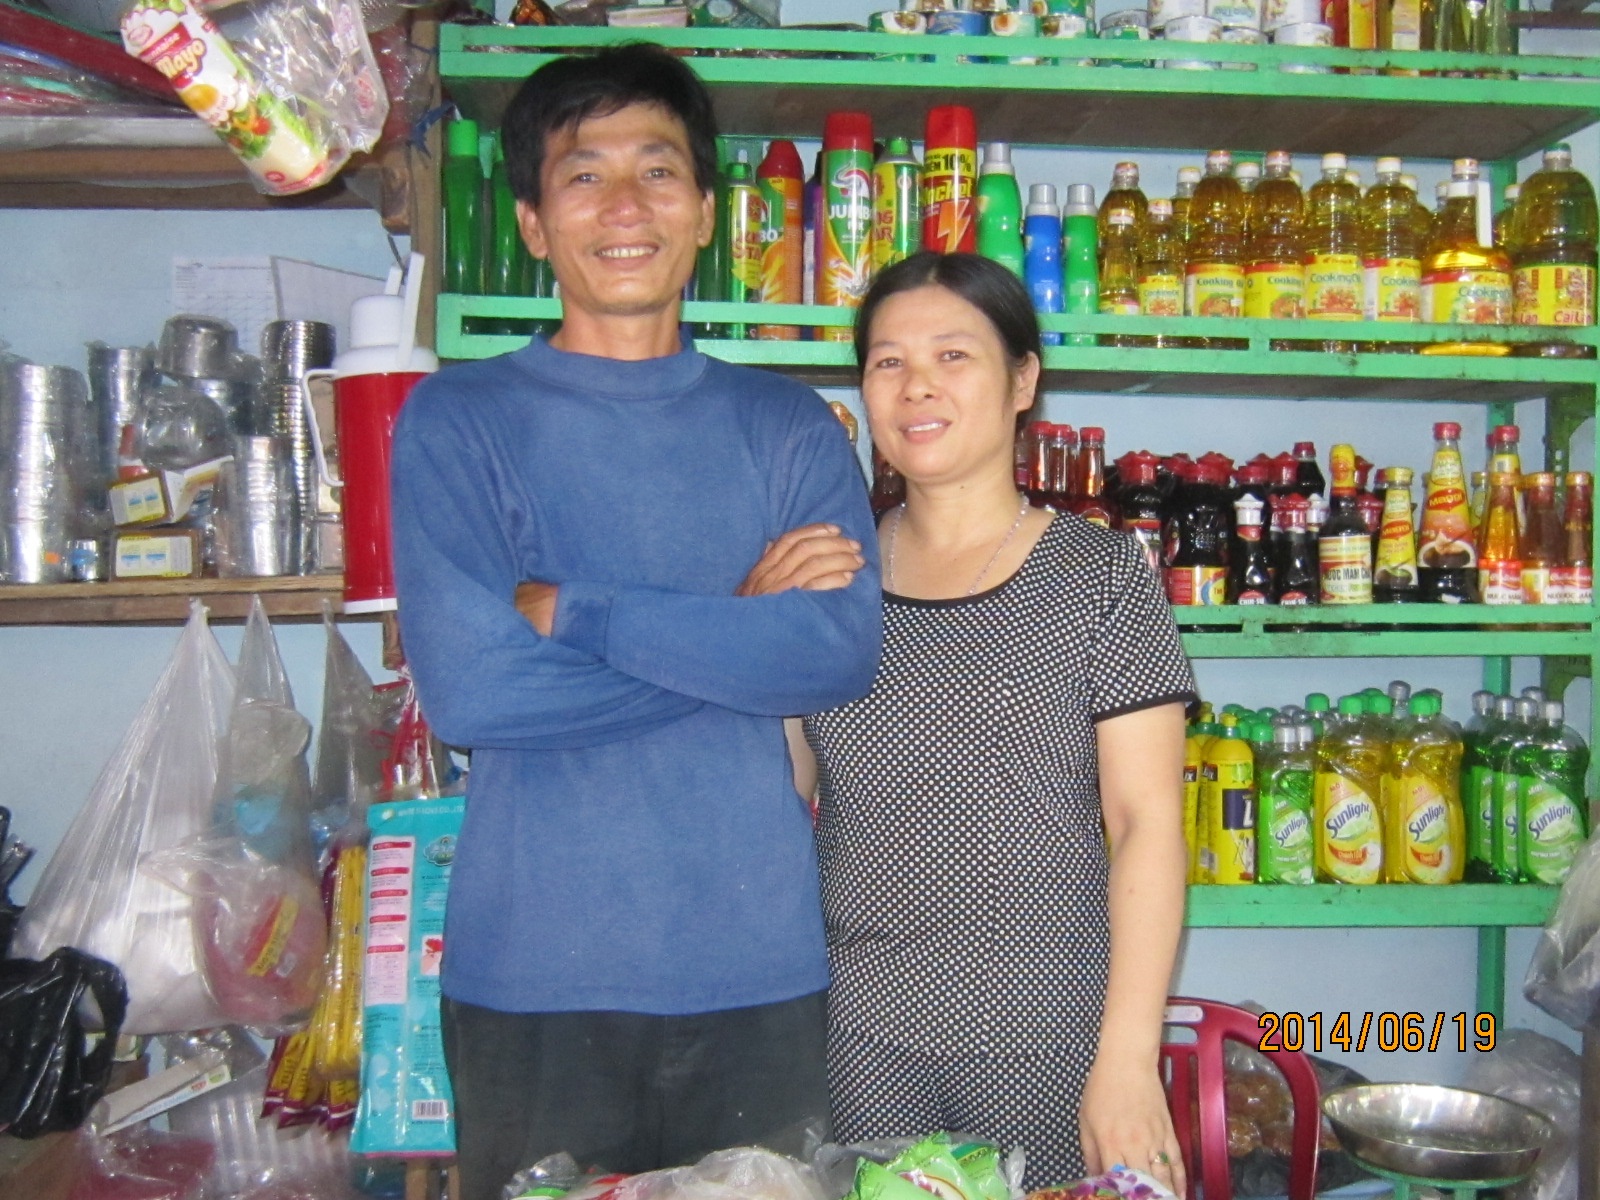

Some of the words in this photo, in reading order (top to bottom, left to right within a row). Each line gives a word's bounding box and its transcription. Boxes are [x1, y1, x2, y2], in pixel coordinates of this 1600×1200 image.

[154, 39, 206, 80] Mayo
[942, 153, 972, 173] 10%
[1325, 803, 1370, 839] Sunlight
[1528, 804, 1572, 841] Sunlight
